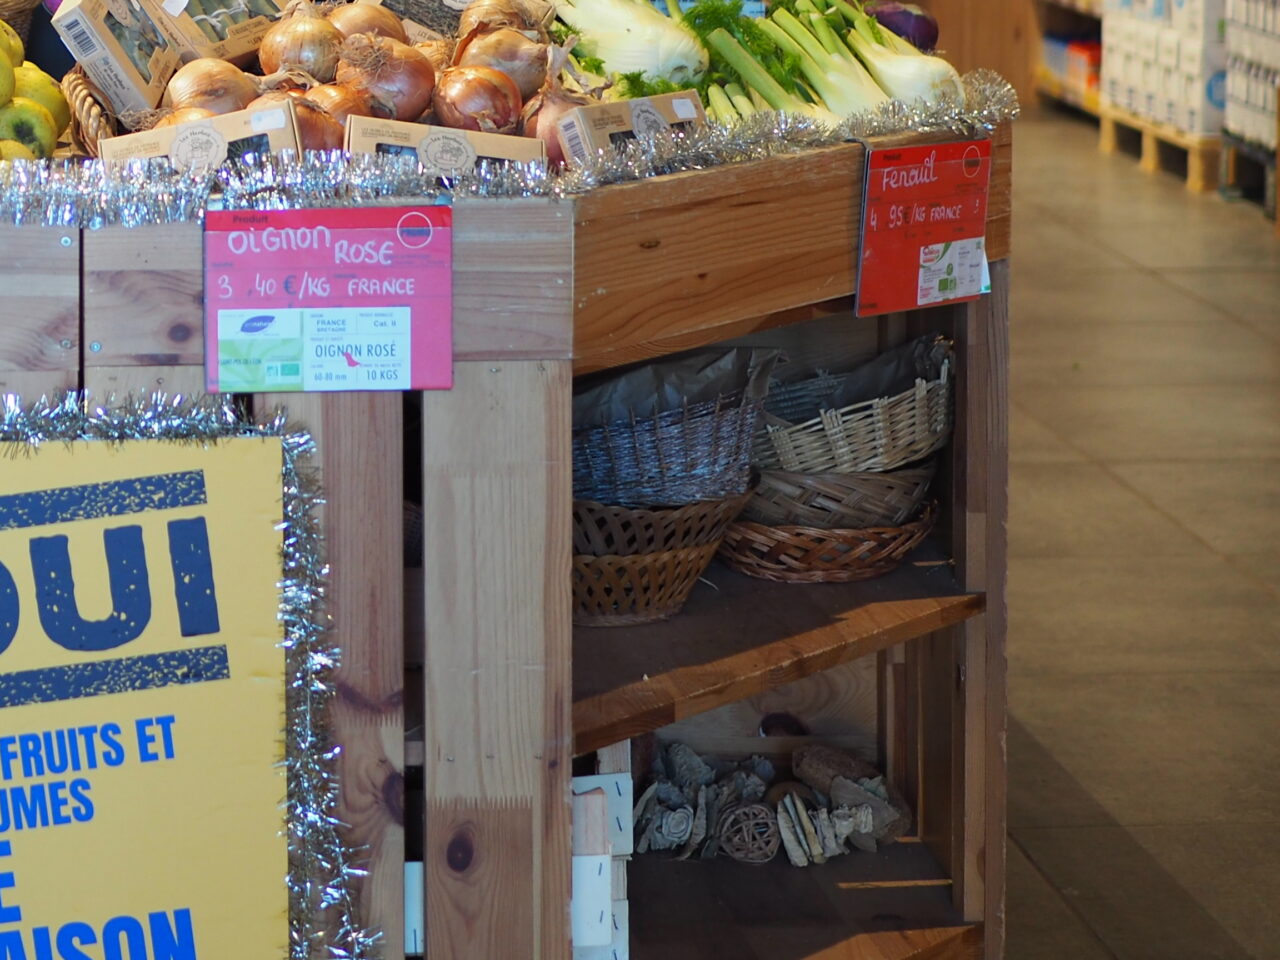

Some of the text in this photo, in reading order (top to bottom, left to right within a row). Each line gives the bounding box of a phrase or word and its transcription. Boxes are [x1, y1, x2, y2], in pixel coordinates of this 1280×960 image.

[232, 215, 269, 224] Produit
[347, 278, 416, 298] FRANCE
[315, 343, 362, 358] OIGNON
[367, 370, 377, 381] 10
[380, 370, 399, 381] KGS
[135, 714, 176, 762] ET
